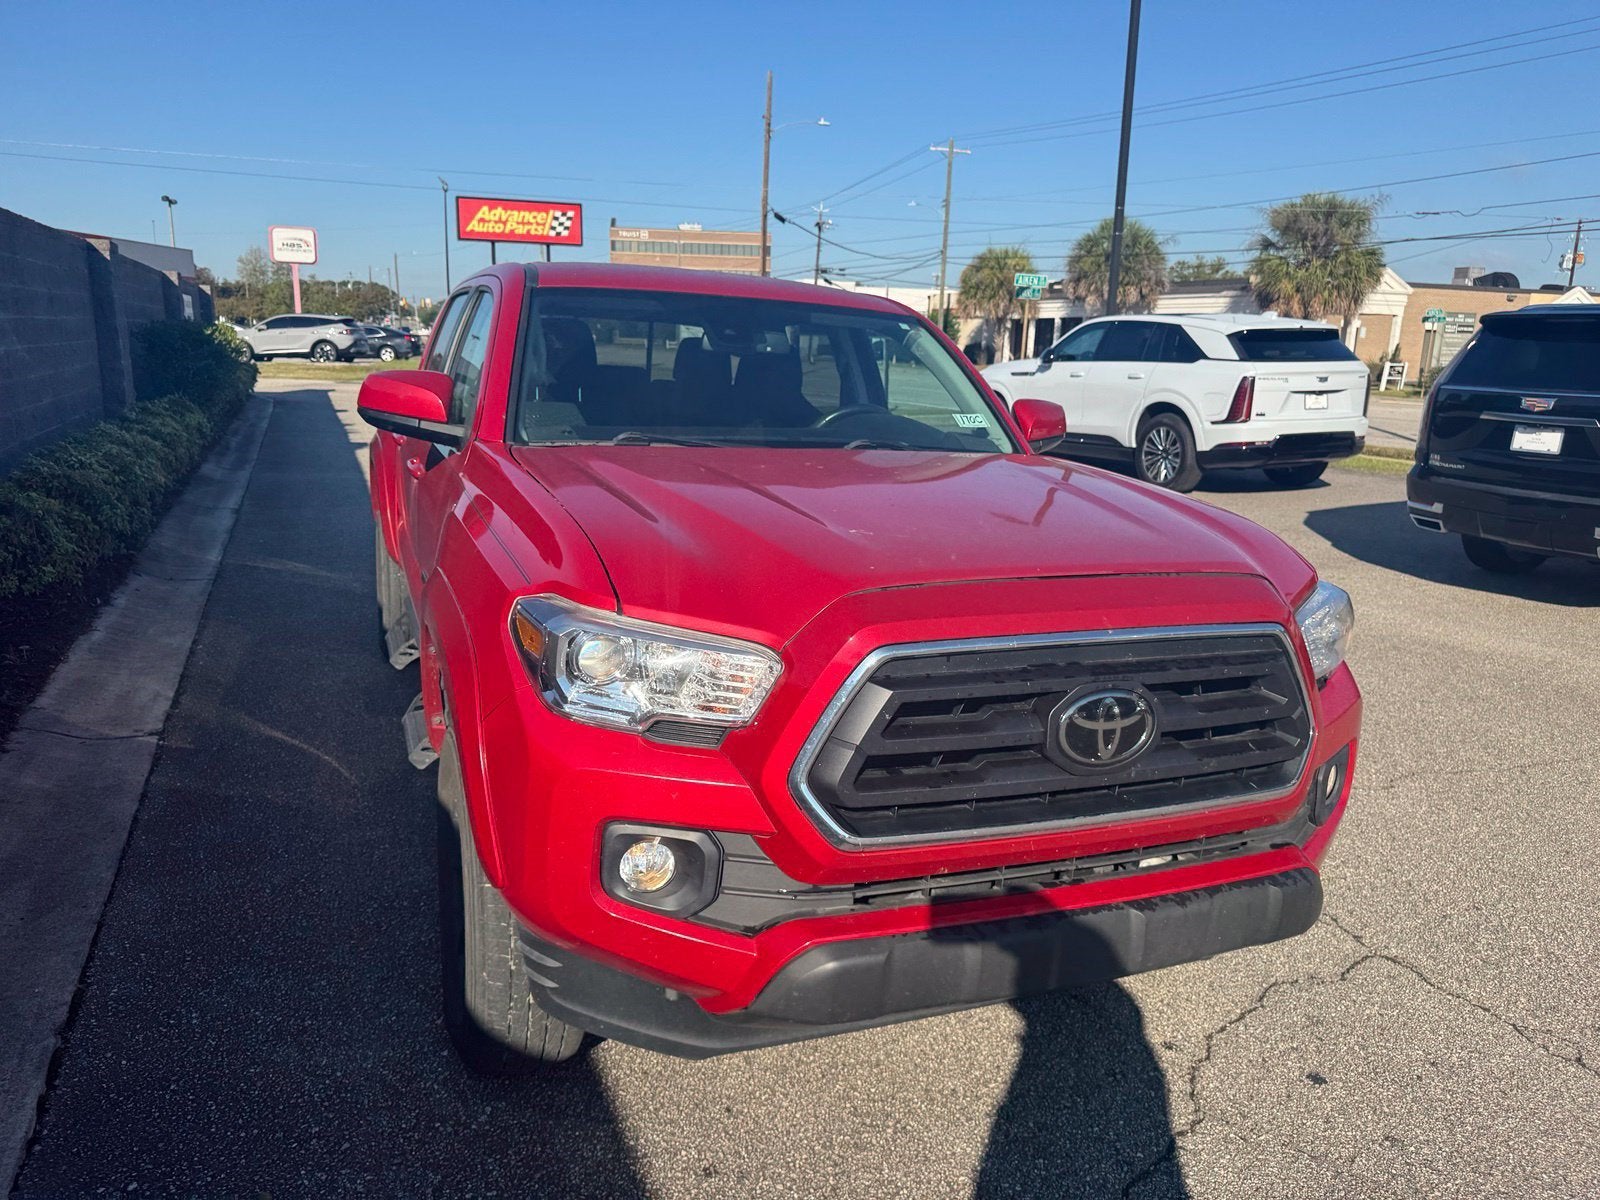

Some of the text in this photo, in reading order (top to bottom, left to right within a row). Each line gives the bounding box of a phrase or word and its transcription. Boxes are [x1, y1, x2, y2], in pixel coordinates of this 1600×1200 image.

[475, 205, 547, 224] Advance
[466, 219, 546, 236] Auto Parts
